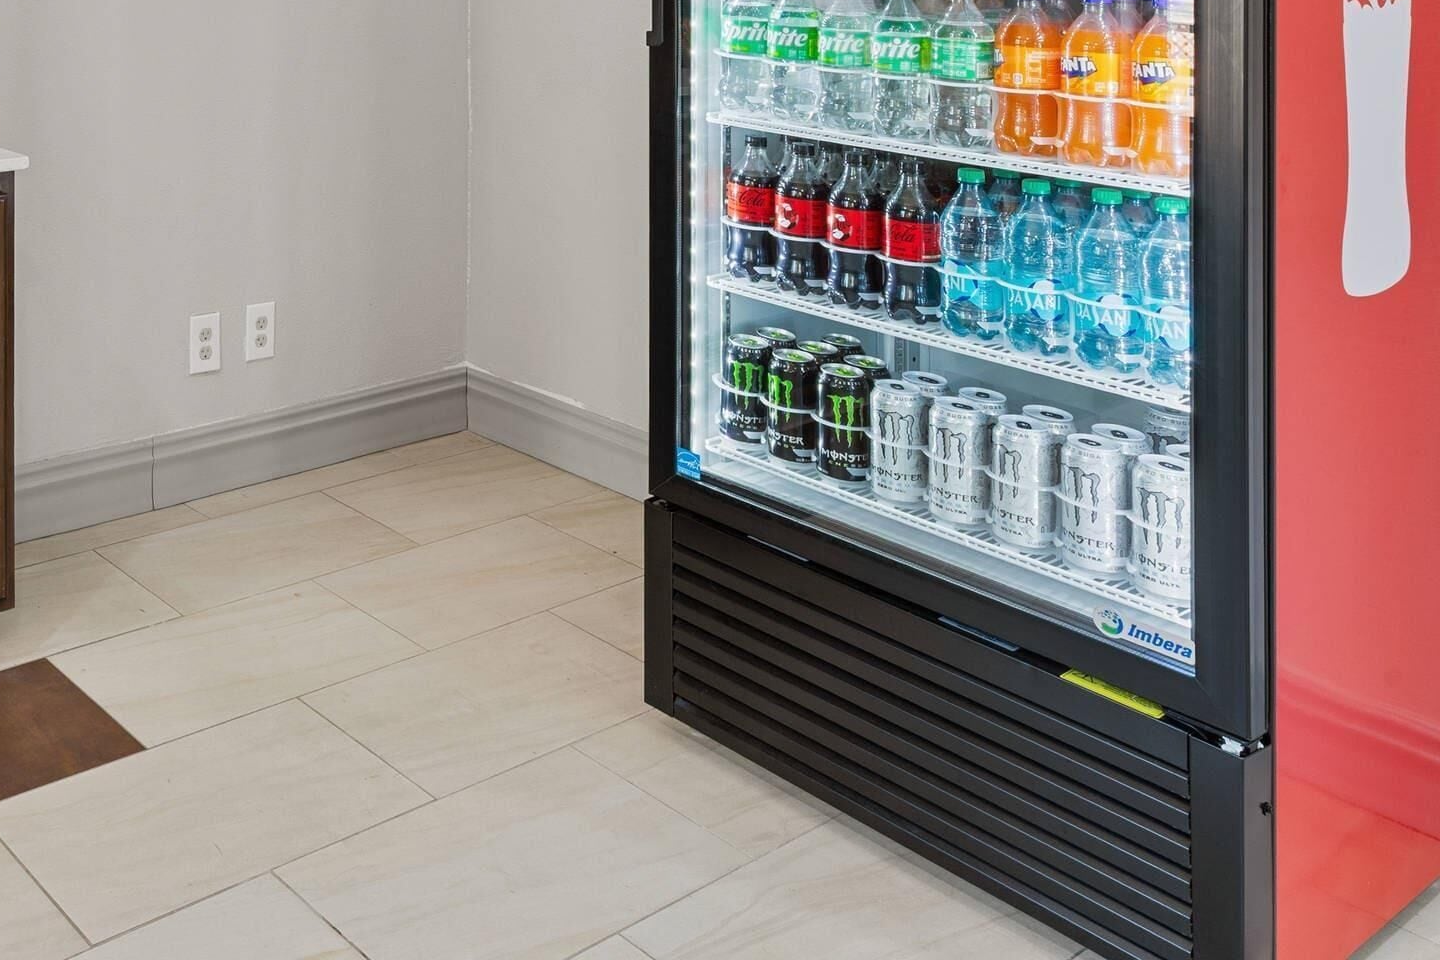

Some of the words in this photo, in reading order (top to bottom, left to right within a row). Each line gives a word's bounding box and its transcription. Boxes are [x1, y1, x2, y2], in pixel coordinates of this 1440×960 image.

[1133, 61, 1175, 79] FANTA
[932, 485, 980, 504] NSTER
[993, 502, 1035, 526] NSTER
[1064, 528, 1115, 551] NSTER
[1136, 552, 1191, 575] ONSTE
[1127, 623, 1192, 658] Imbera
